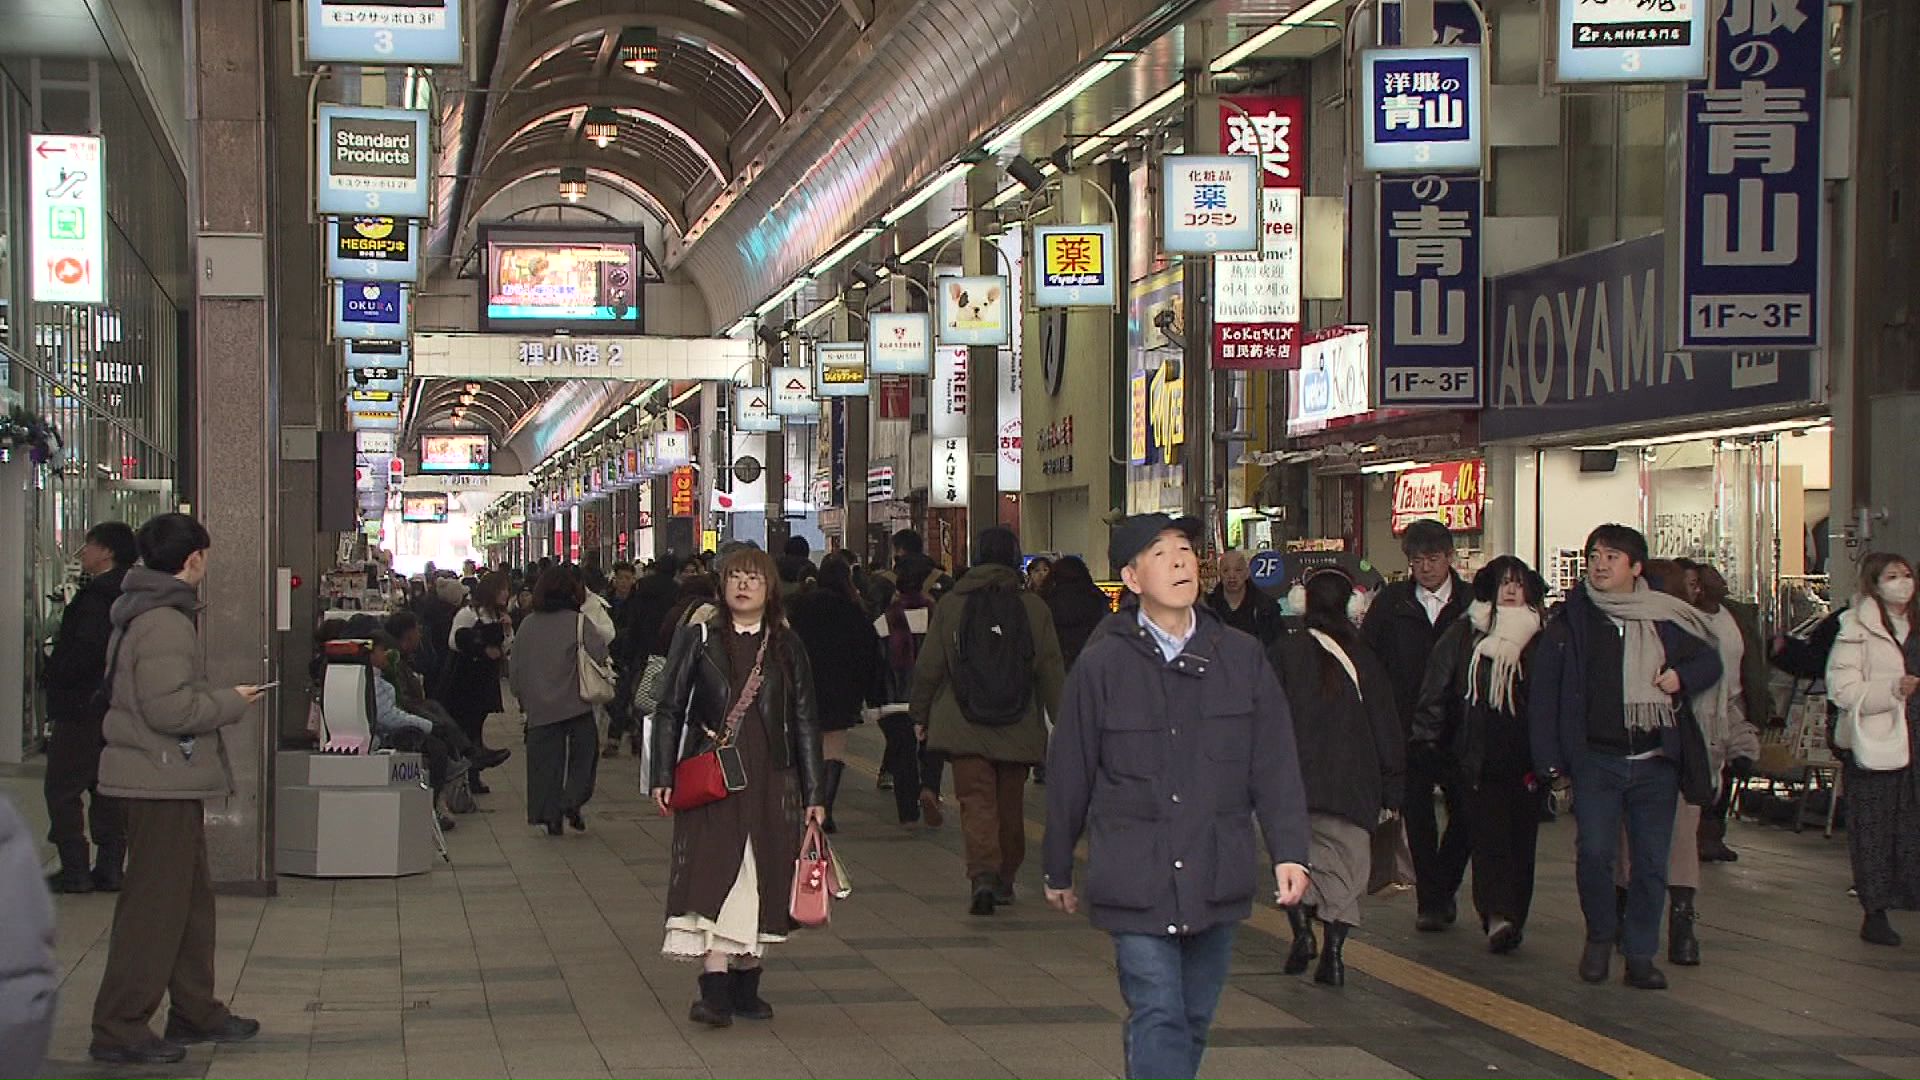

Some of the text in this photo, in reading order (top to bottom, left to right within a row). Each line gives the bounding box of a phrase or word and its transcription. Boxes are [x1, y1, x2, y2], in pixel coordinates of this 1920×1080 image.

[373, 29, 393, 53] 3
[1579, 26, 1600, 42] 2F
[1621, 50, 1641, 71] 3
[1384, 72, 1460, 94] 洋服の
[1381, 94, 1464, 130] 青山
[337, 131, 410, 149] Standard
[337, 147, 410, 164] Products
[1414, 145, 1430, 162] 3
[1189, 170, 1232, 182] 化粧品
[366, 193, 380, 209] 3
[1194, 184, 1227, 210] 薬
[1184, 213, 1237, 226] コクミン
[1205, 232, 1217, 248] 3
[1055, 237, 1091, 272] 薬
[519, 342, 624, 367] 狸小路 2
[954, 349, 966, 415] STREET
[1255, 558, 1278, 578] 2F
[391, 762, 420, 782] AQUA
